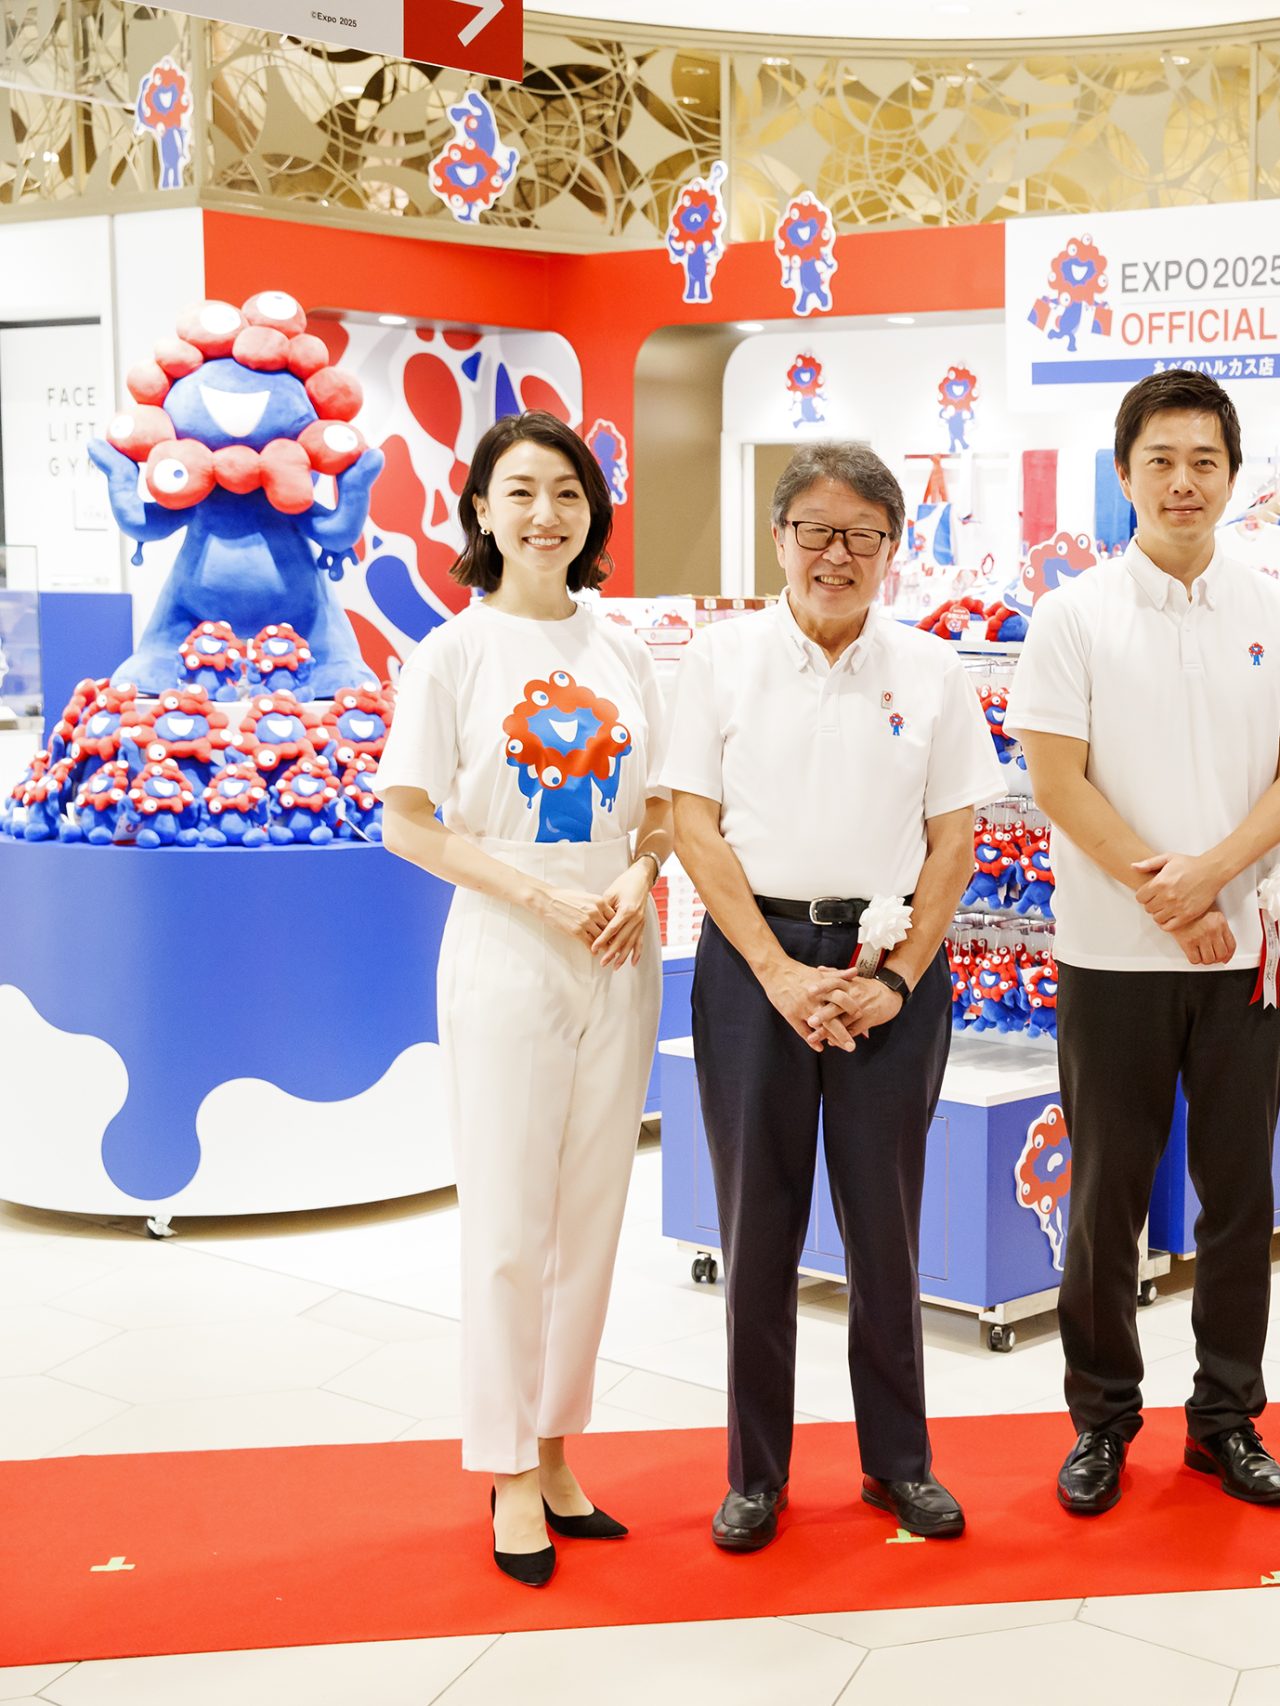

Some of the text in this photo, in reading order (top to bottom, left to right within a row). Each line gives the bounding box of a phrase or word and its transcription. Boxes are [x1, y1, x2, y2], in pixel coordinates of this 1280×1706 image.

[339, 17, 358, 28] 2025
[1121, 307, 1278, 346] OFFICIAL
[48, 387, 96, 406] FACE
[49, 422, 97, 442] LIFT
